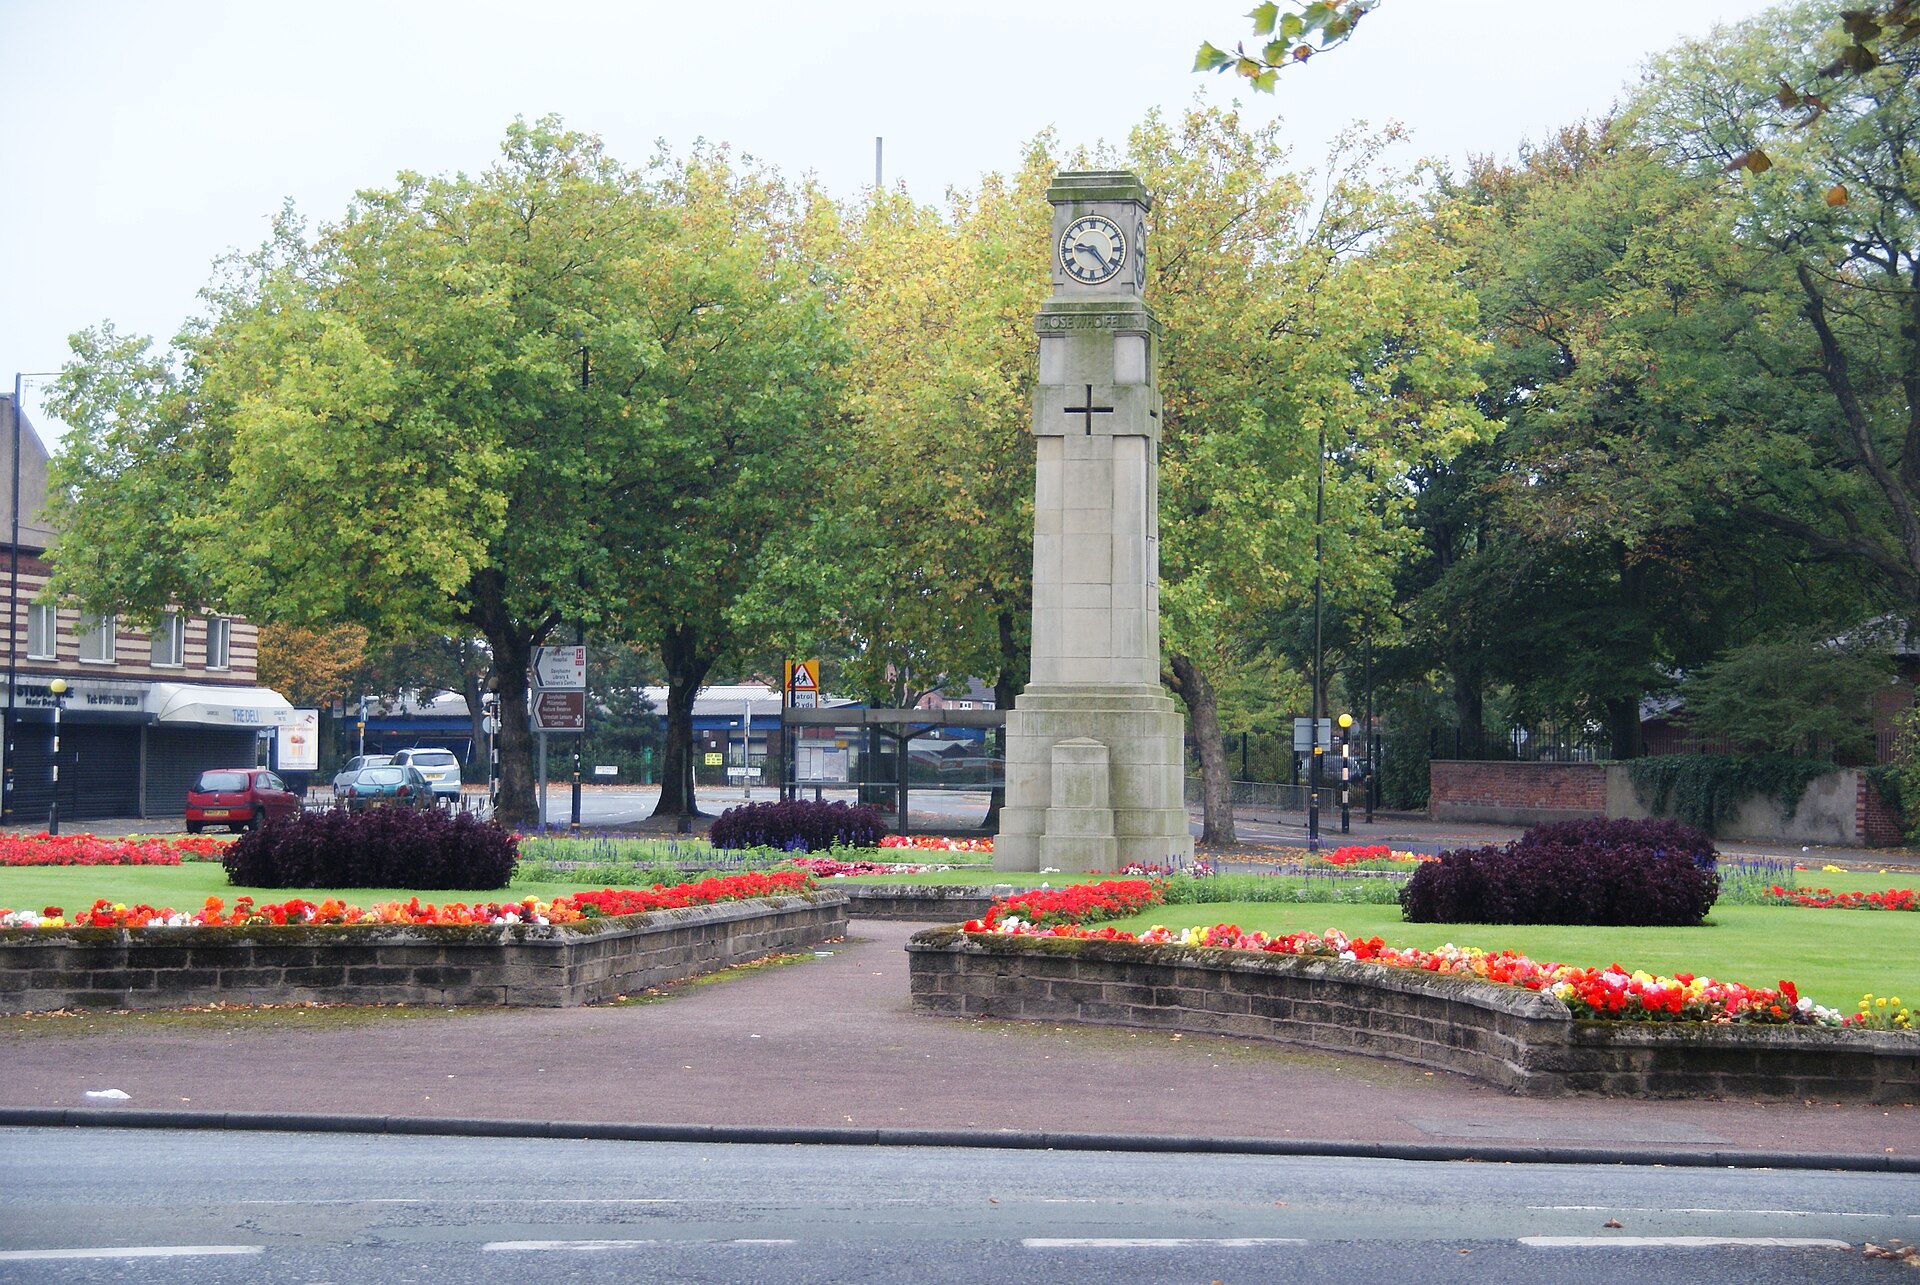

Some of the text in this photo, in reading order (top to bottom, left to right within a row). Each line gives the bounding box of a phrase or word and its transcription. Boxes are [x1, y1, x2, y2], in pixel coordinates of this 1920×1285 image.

[1037, 316, 1074, 329] THOSE
[1075, 316, 1104, 329] WHO
[16, 685, 53, 698] STUDIO
[26, 698, 41, 706] Hair
[232, 708, 245, 723] THE
[245, 709, 260, 723] DELI
